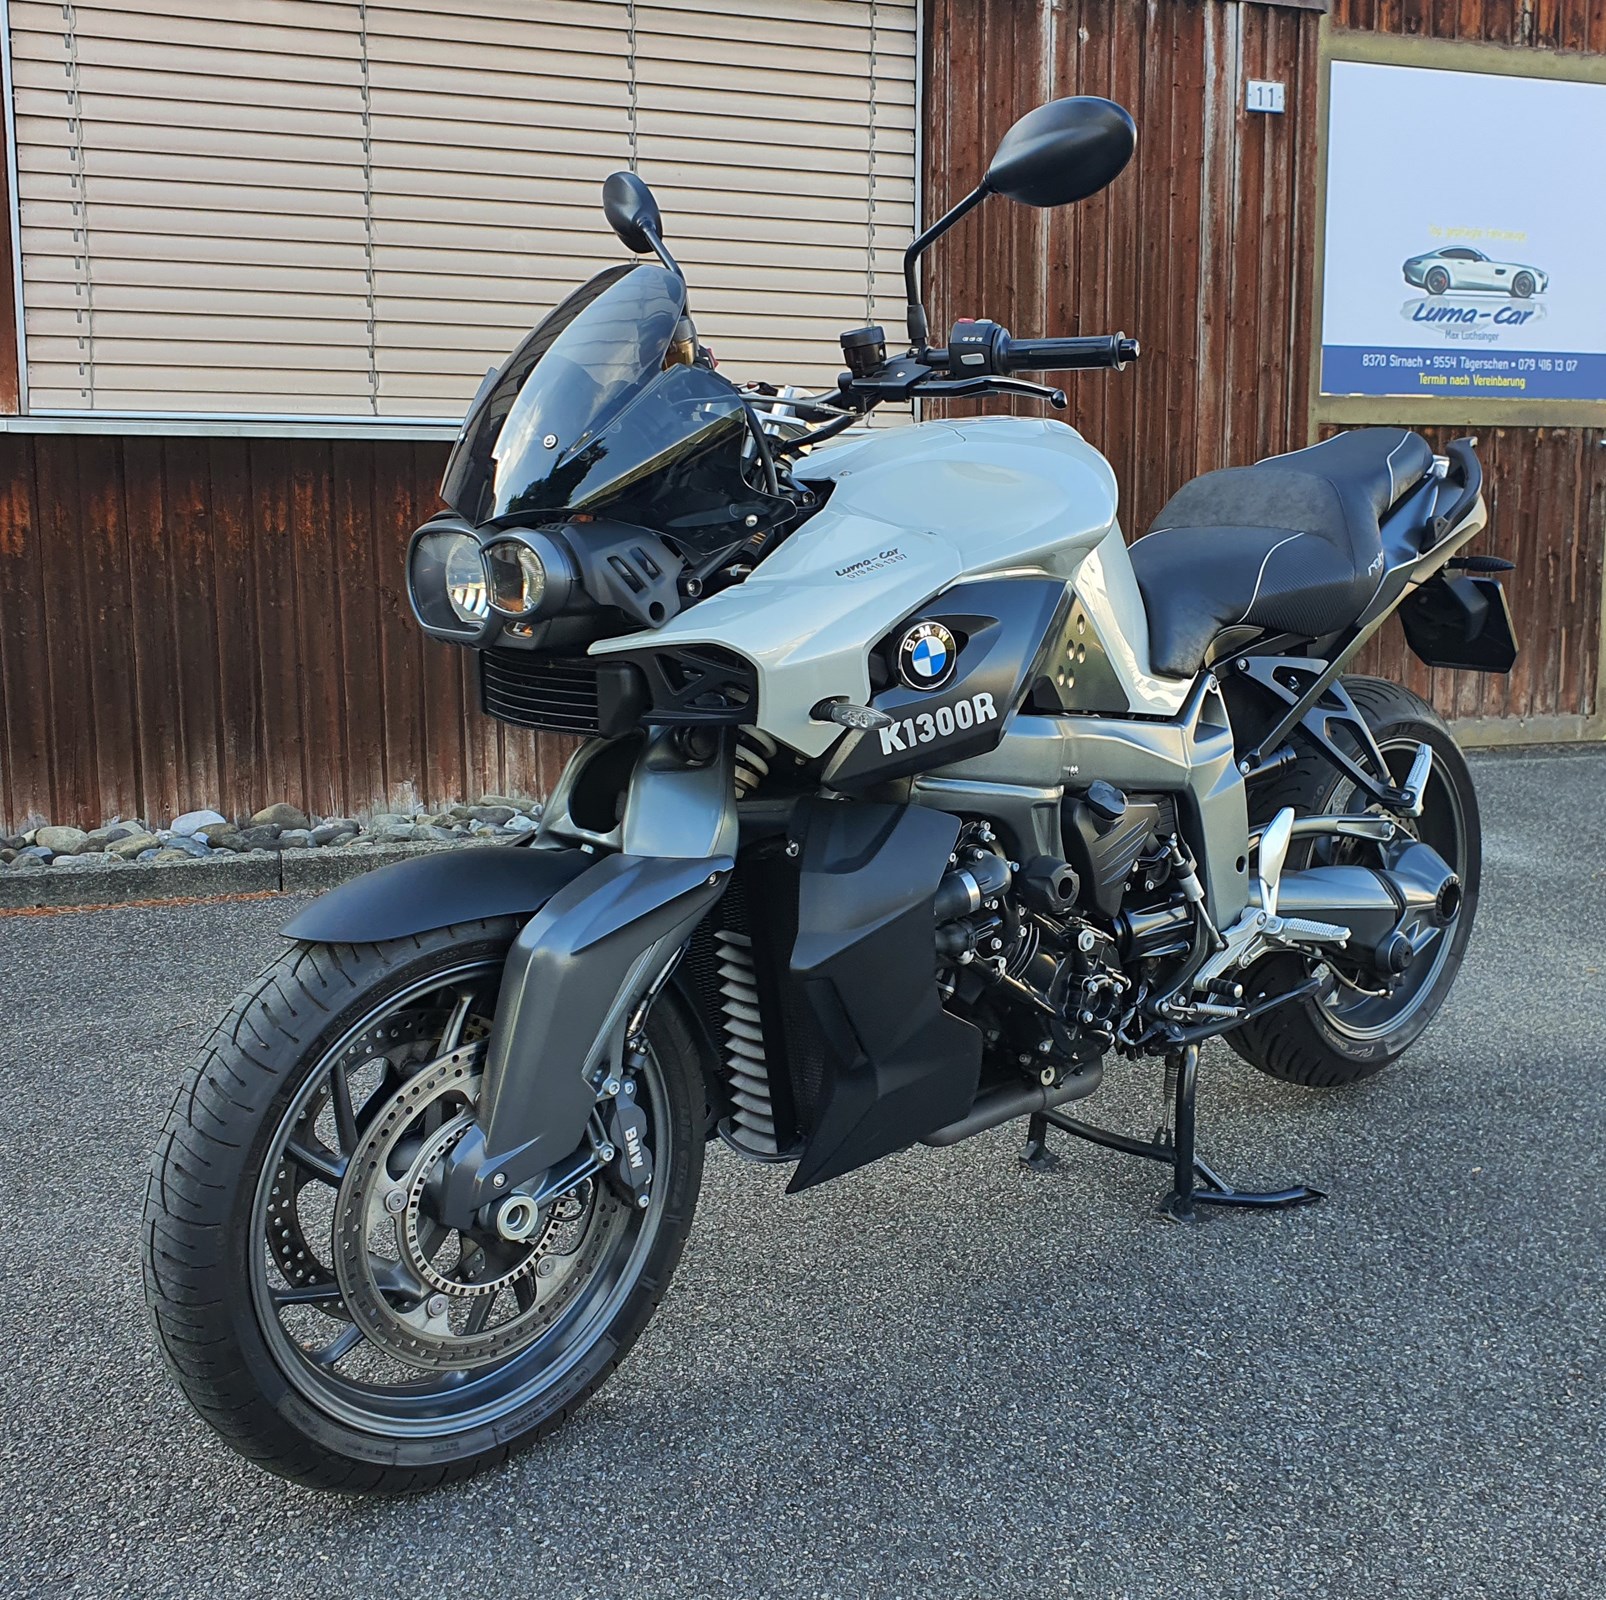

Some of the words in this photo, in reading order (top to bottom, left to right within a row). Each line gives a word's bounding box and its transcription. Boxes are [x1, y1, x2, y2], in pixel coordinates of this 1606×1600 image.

[1257, 86, 1274, 108] 11
[1411, 302, 1535, 326] Luma-Car
[1444, 329, 1460, 340] Max
[1362, 353, 1387, 367] 8370
[1389, 354, 1423, 368] Sirnach
[1433, 355, 1457, 369] 9554
[1460, 356, 1509, 372] Tägerschen
[1518, 358, 1536, 371] 079
[1538, 358, 1552, 372] 416
[1555, 360, 1564, 372] 13
[1565, 359, 1578, 372] 07
[1419, 372, 1447, 385] Termin
[1449, 375, 1470, 386] nach
[1473, 374, 1526, 390] Vereinbarung
[834, 547, 899, 577] Luma-Car
[903, 624, 951, 652] BMW
[878, 691, 998, 756] K1300R
[624, 1126, 644, 1169] BMW
